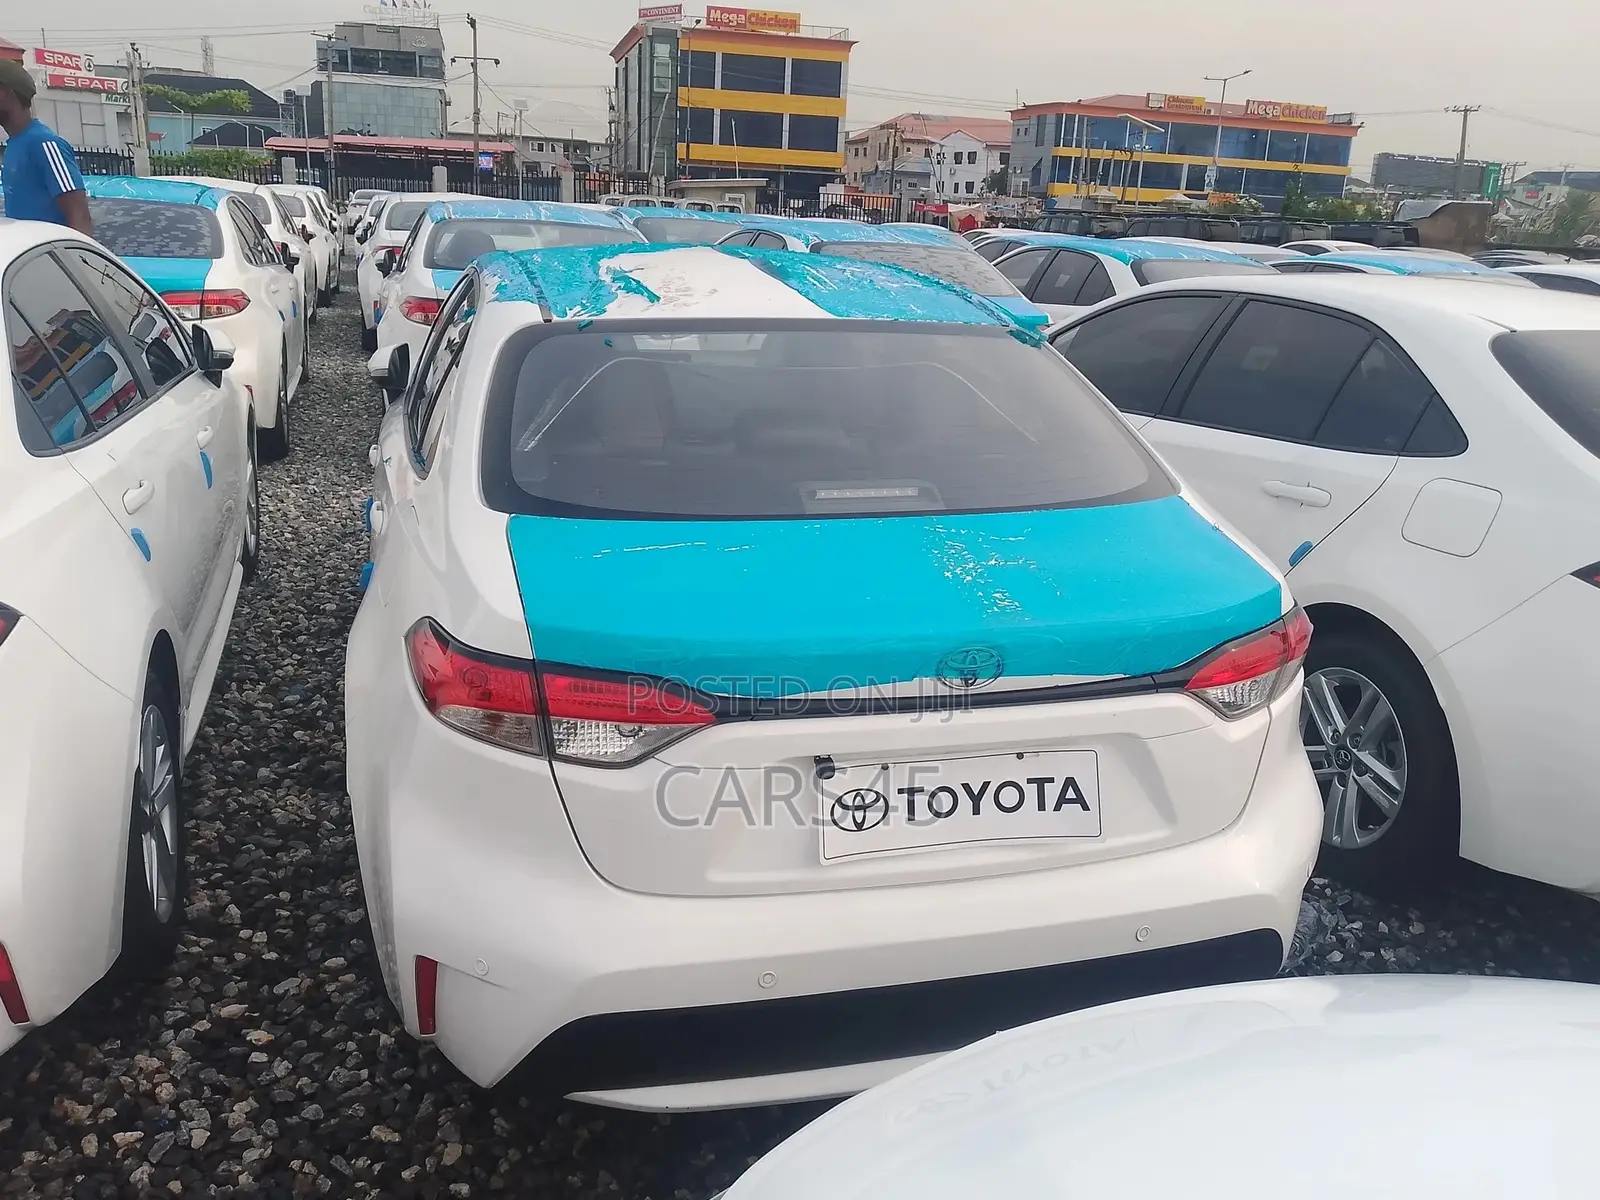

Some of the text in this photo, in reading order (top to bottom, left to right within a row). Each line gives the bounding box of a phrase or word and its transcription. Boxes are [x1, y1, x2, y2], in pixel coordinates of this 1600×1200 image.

[647, 6, 680, 16] CONTINENT
[709, 9, 797, 30] Mega Chicken
[43, 52, 81, 67] SPAR
[64, 77, 117, 90] SPAR
[1247, 100, 1326, 120] Mega Chicken
[897, 776, 1092, 824] TOYOTA
